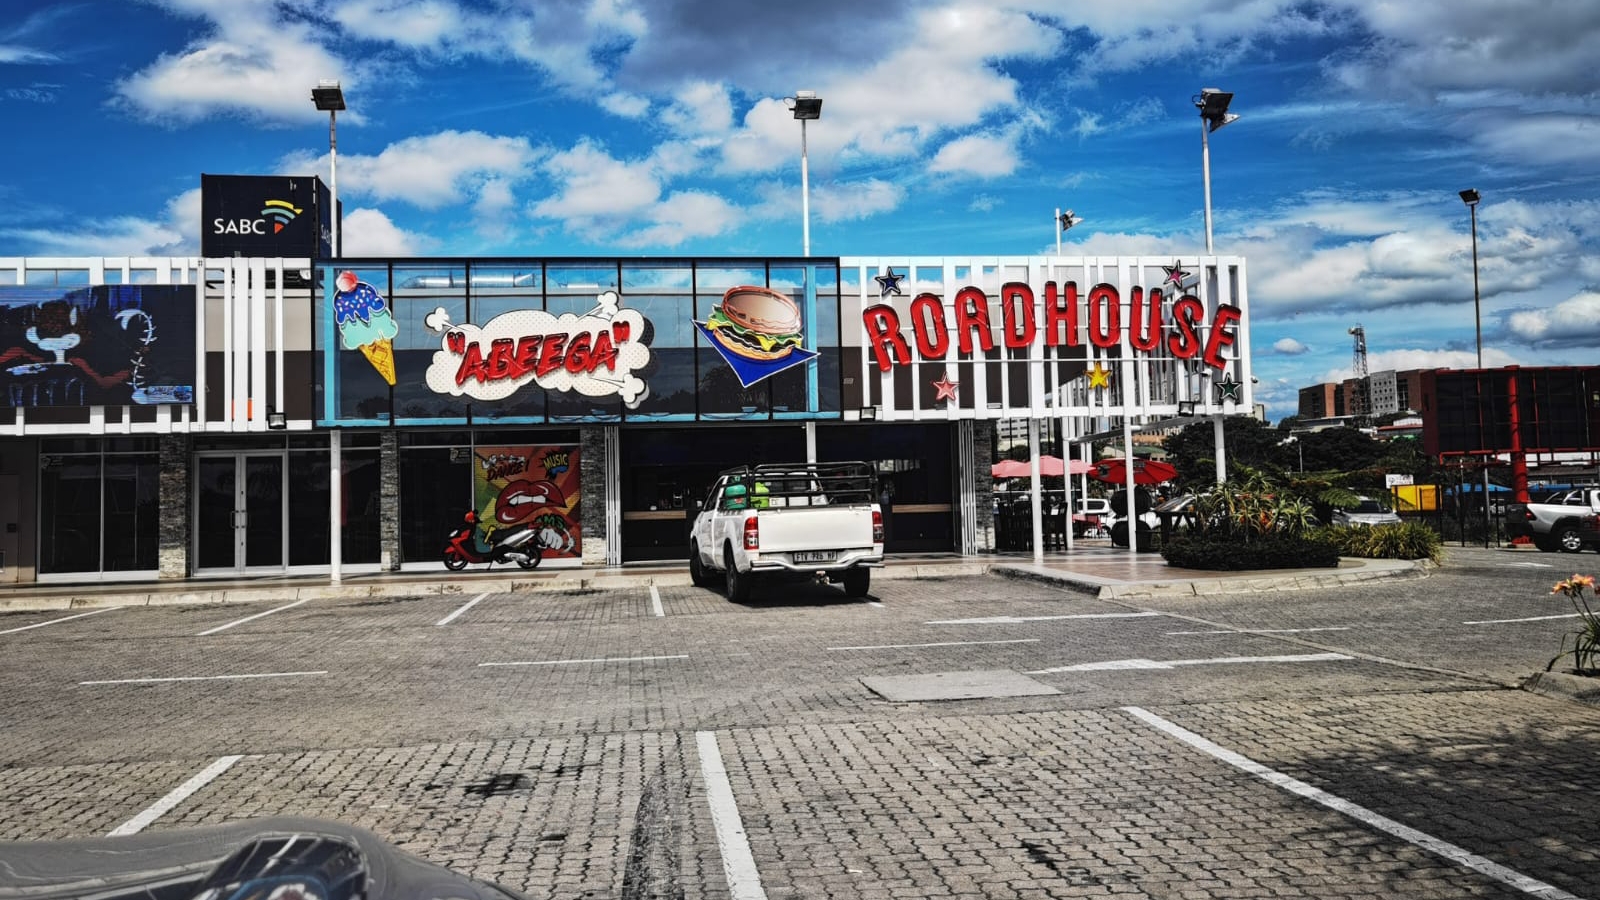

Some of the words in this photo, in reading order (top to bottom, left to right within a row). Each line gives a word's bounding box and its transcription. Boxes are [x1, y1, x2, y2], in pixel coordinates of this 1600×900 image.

[213, 218, 266, 235] SABC
[863, 280, 1242, 372] ROADHOUSE
[447, 322, 629, 386] "ABEEGA"
[543, 453, 568, 469] MUSIC
